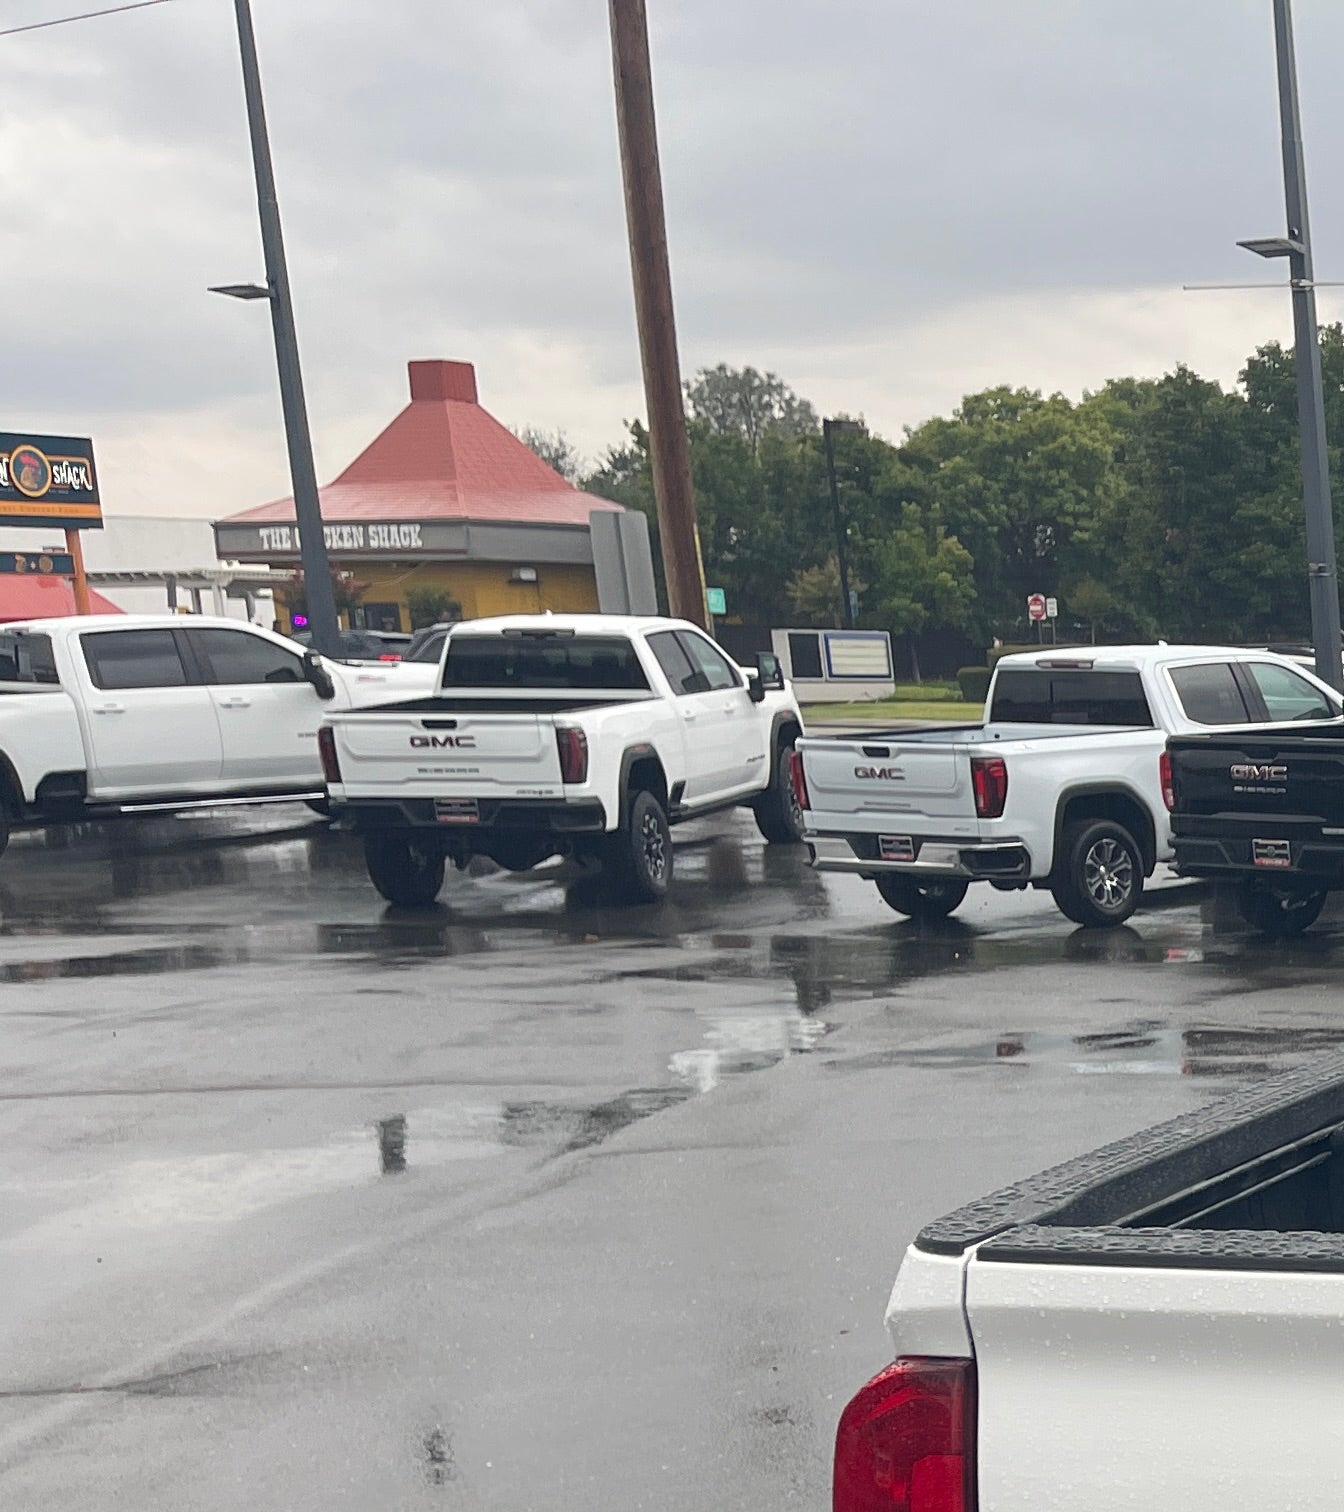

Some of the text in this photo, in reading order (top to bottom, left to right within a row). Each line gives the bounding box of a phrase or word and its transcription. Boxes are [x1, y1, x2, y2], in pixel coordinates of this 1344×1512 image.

[53, 460, 93, 491] SHACK
[259, 524, 423, 550] THE CKEN SHACK
[410, 735, 476, 748] GMC
[854, 767, 905, 781] GMC
[1230, 764, 1288, 781] GMC
